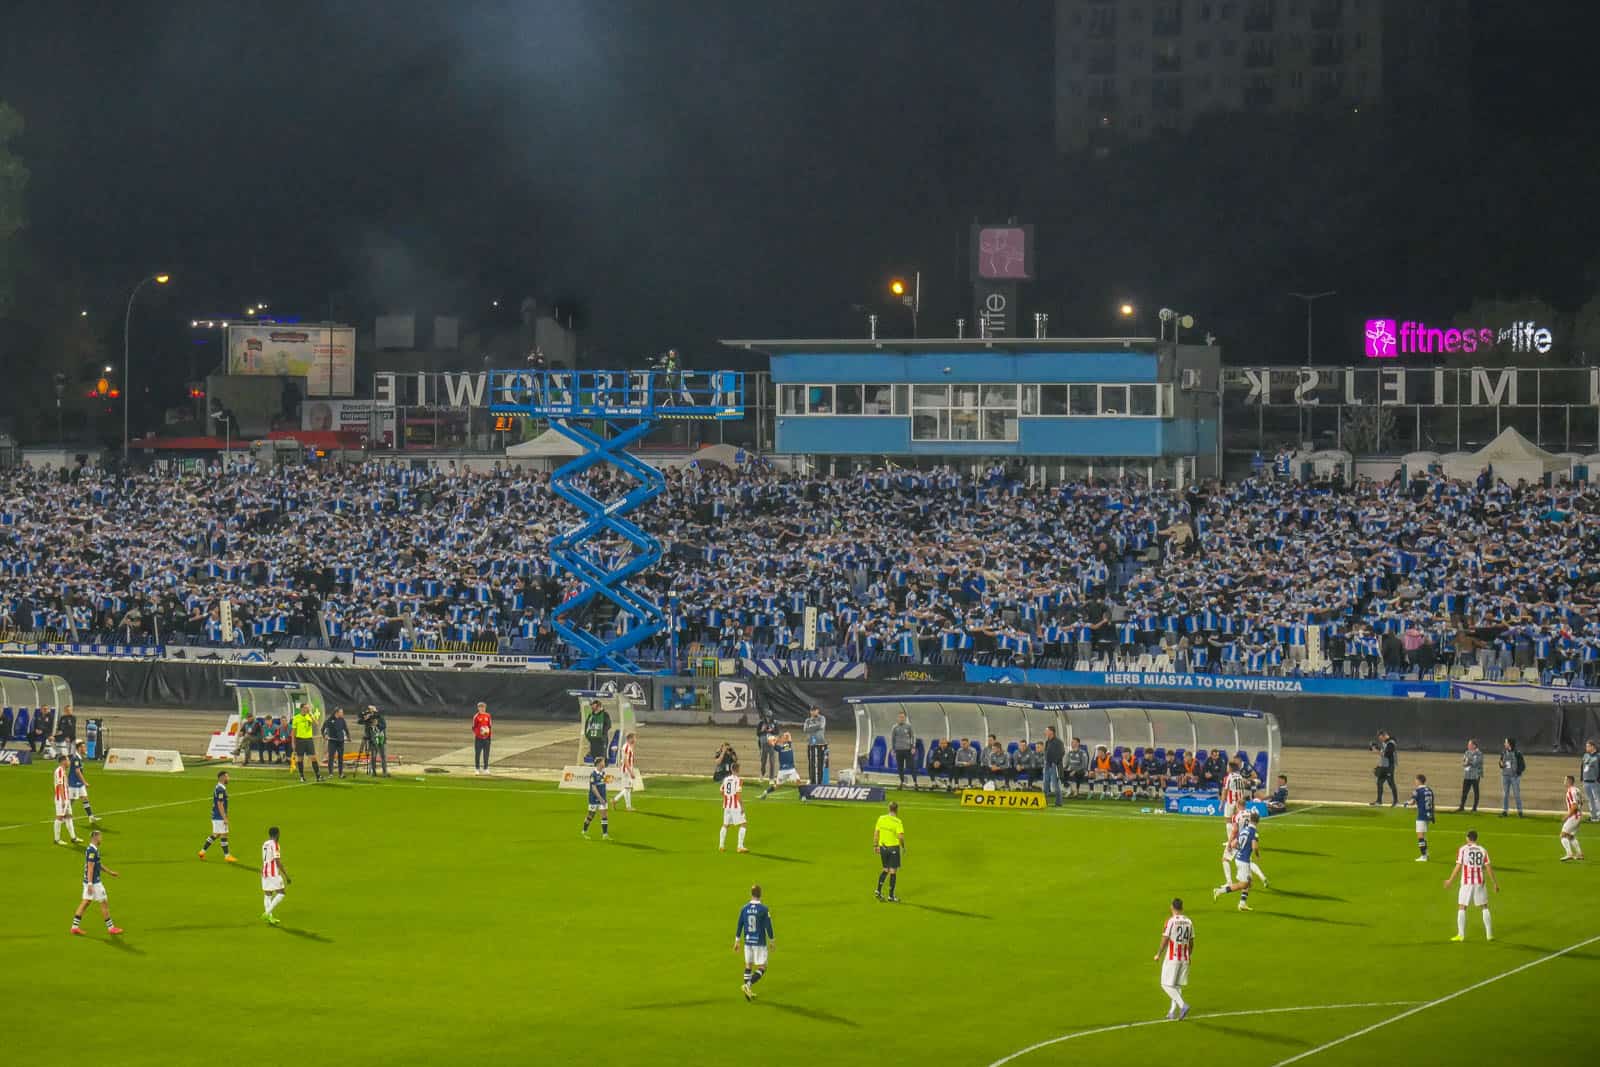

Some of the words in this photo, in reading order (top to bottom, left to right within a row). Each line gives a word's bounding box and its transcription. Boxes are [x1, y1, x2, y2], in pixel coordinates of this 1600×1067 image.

[1400, 320, 1494, 352] fitness
[1512, 320, 1552, 353] life
[1104, 673, 1140, 685] HERB
[1144, 674, 1193, 686] MIASTA
[1195, 675, 1213, 688] TO
[1215, 678, 1303, 692] POTWIERDZA
[963, 793, 1041, 807] FORTUNA
[1468, 851, 1483, 866] 38
[748, 914, 757, 933] 9
[1176, 926, 1190, 942] 24
